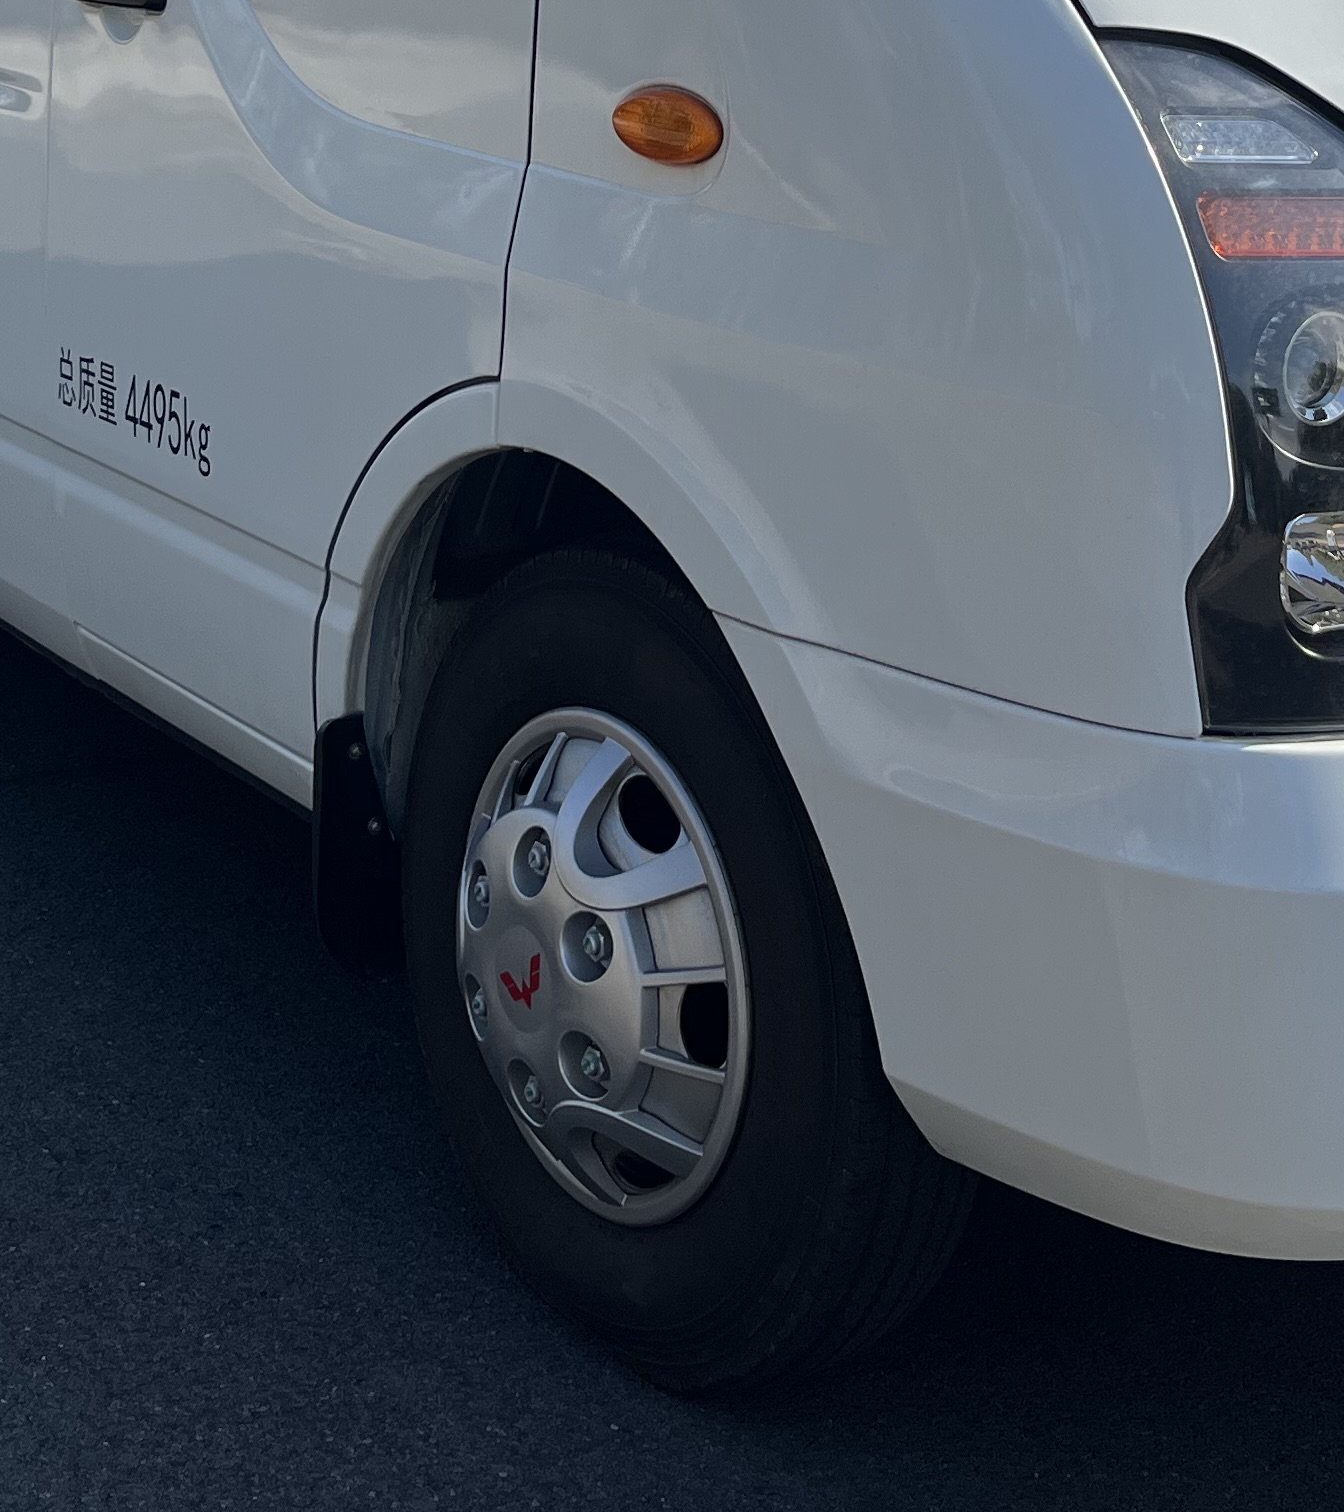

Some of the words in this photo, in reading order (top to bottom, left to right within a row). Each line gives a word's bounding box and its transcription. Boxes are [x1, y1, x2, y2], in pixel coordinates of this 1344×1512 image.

[57, 346, 118, 426] 总质量
[124, 374, 212, 477] 4495kg
